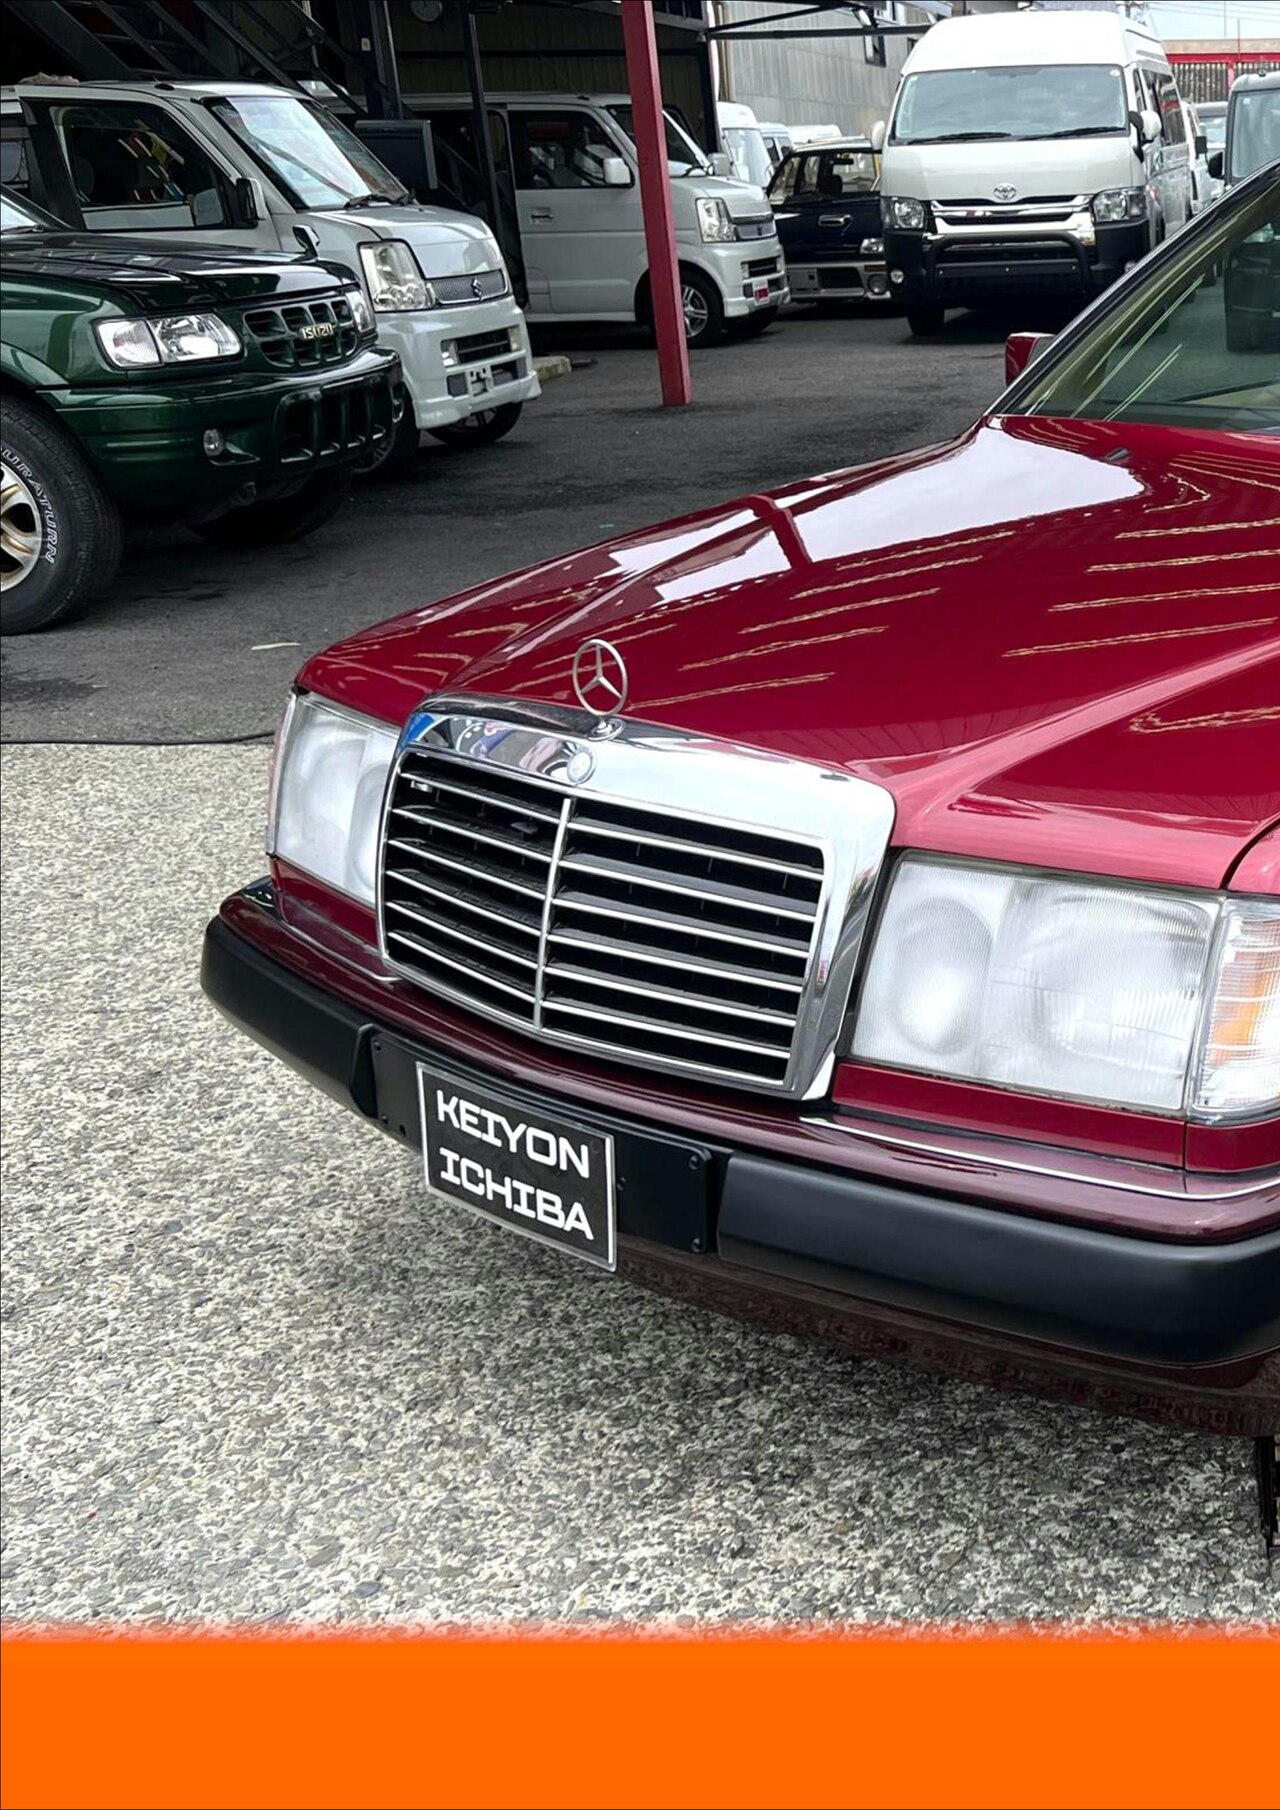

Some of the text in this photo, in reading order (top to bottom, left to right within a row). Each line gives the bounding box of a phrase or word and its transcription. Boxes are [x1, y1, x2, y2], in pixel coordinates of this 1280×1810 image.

[301, 322, 334, 340] ISUZU
[0, 443, 58, 563] URATURN
[436, 1089, 590, 1179] KEIYON
[439, 1146, 595, 1241] ICHIBA
